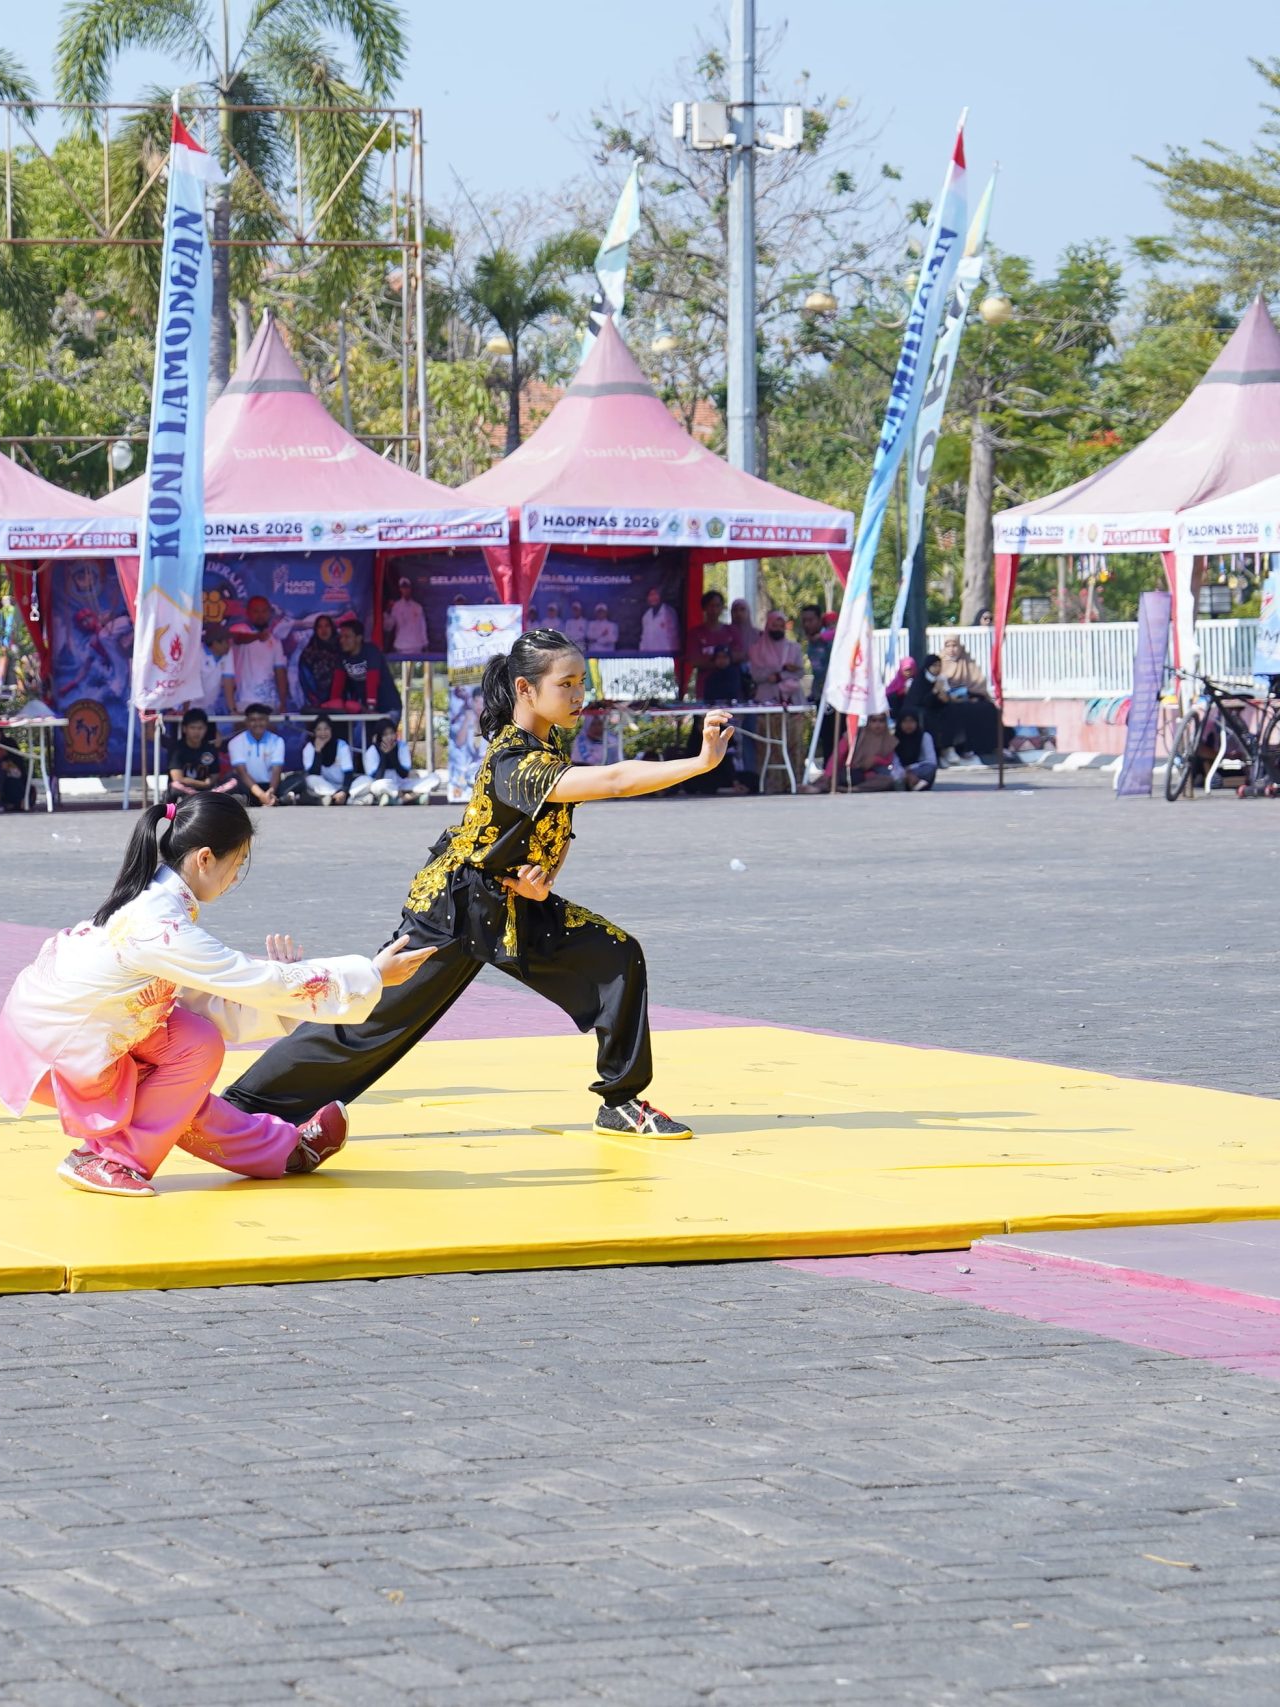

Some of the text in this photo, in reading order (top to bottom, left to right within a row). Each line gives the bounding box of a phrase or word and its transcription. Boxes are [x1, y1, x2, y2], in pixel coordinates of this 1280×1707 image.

[149, 205, 204, 560] KONI LAMONGAN
[204, 522, 303, 535] ORNAS 2026
[543, 515, 660, 529] HAORNAS 2026
[380, 524, 502, 540] TARUNG DERAJAT
[731, 526, 812, 541] PANAHAN
[10, 533, 131, 548] PANJAT TEBING
